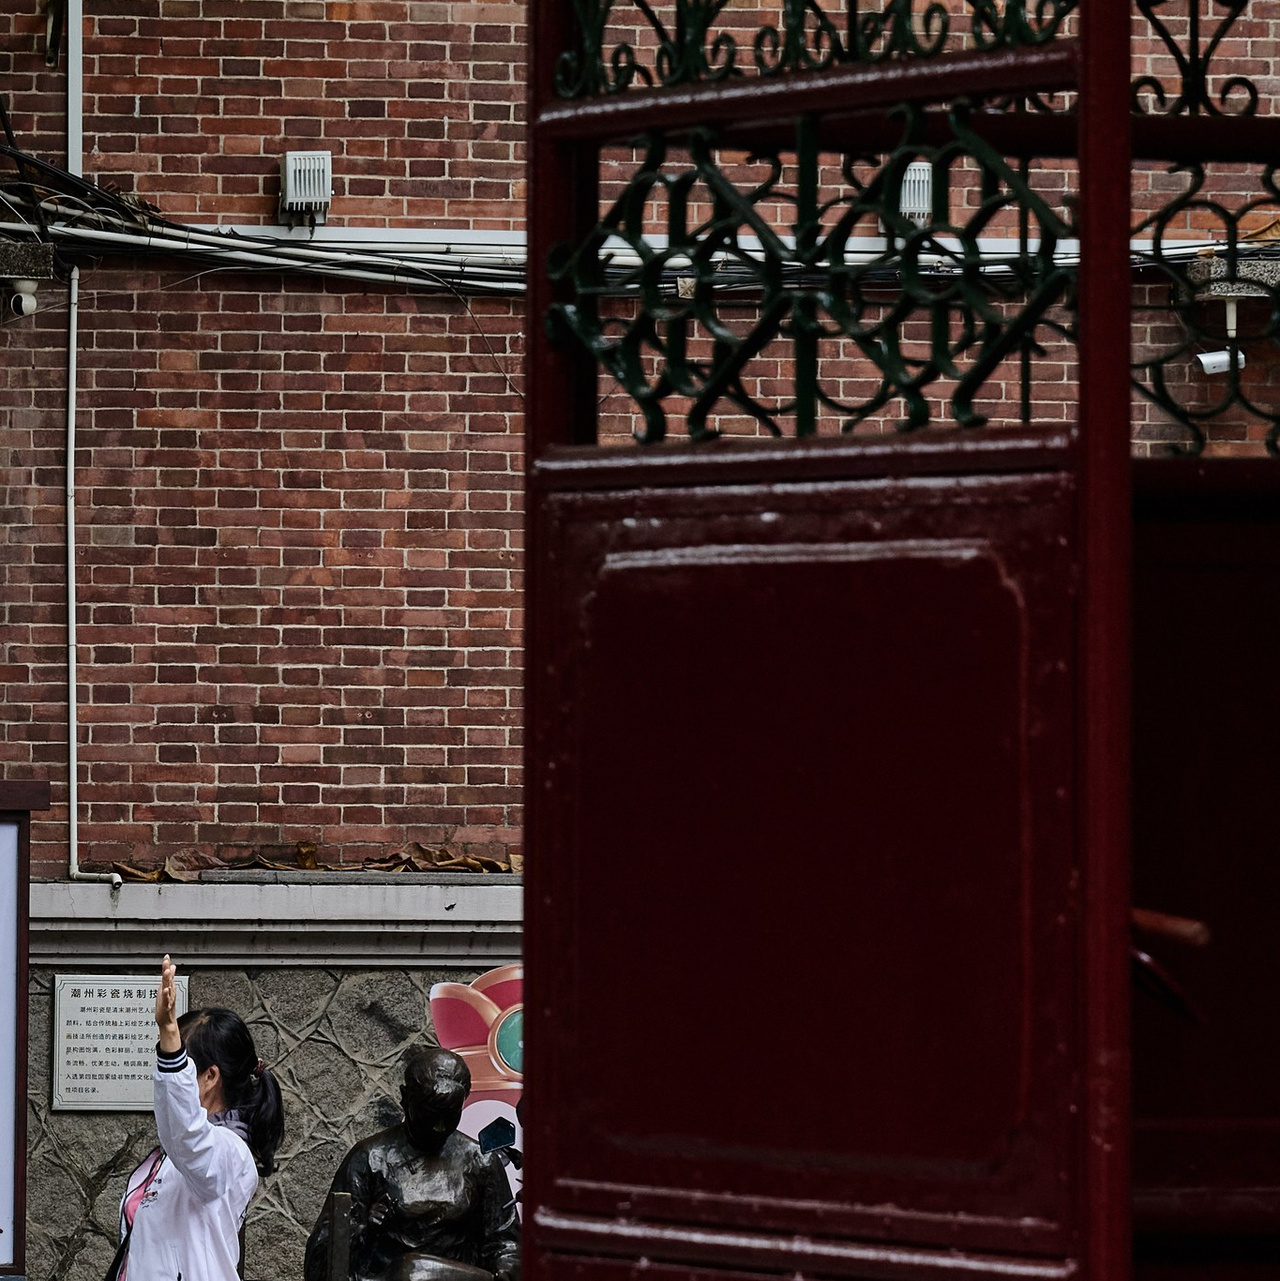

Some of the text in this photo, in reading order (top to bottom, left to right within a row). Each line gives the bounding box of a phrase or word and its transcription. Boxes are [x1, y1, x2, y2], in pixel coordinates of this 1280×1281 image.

[70, 988, 158, 999] 潮州彩瓷烧制技
